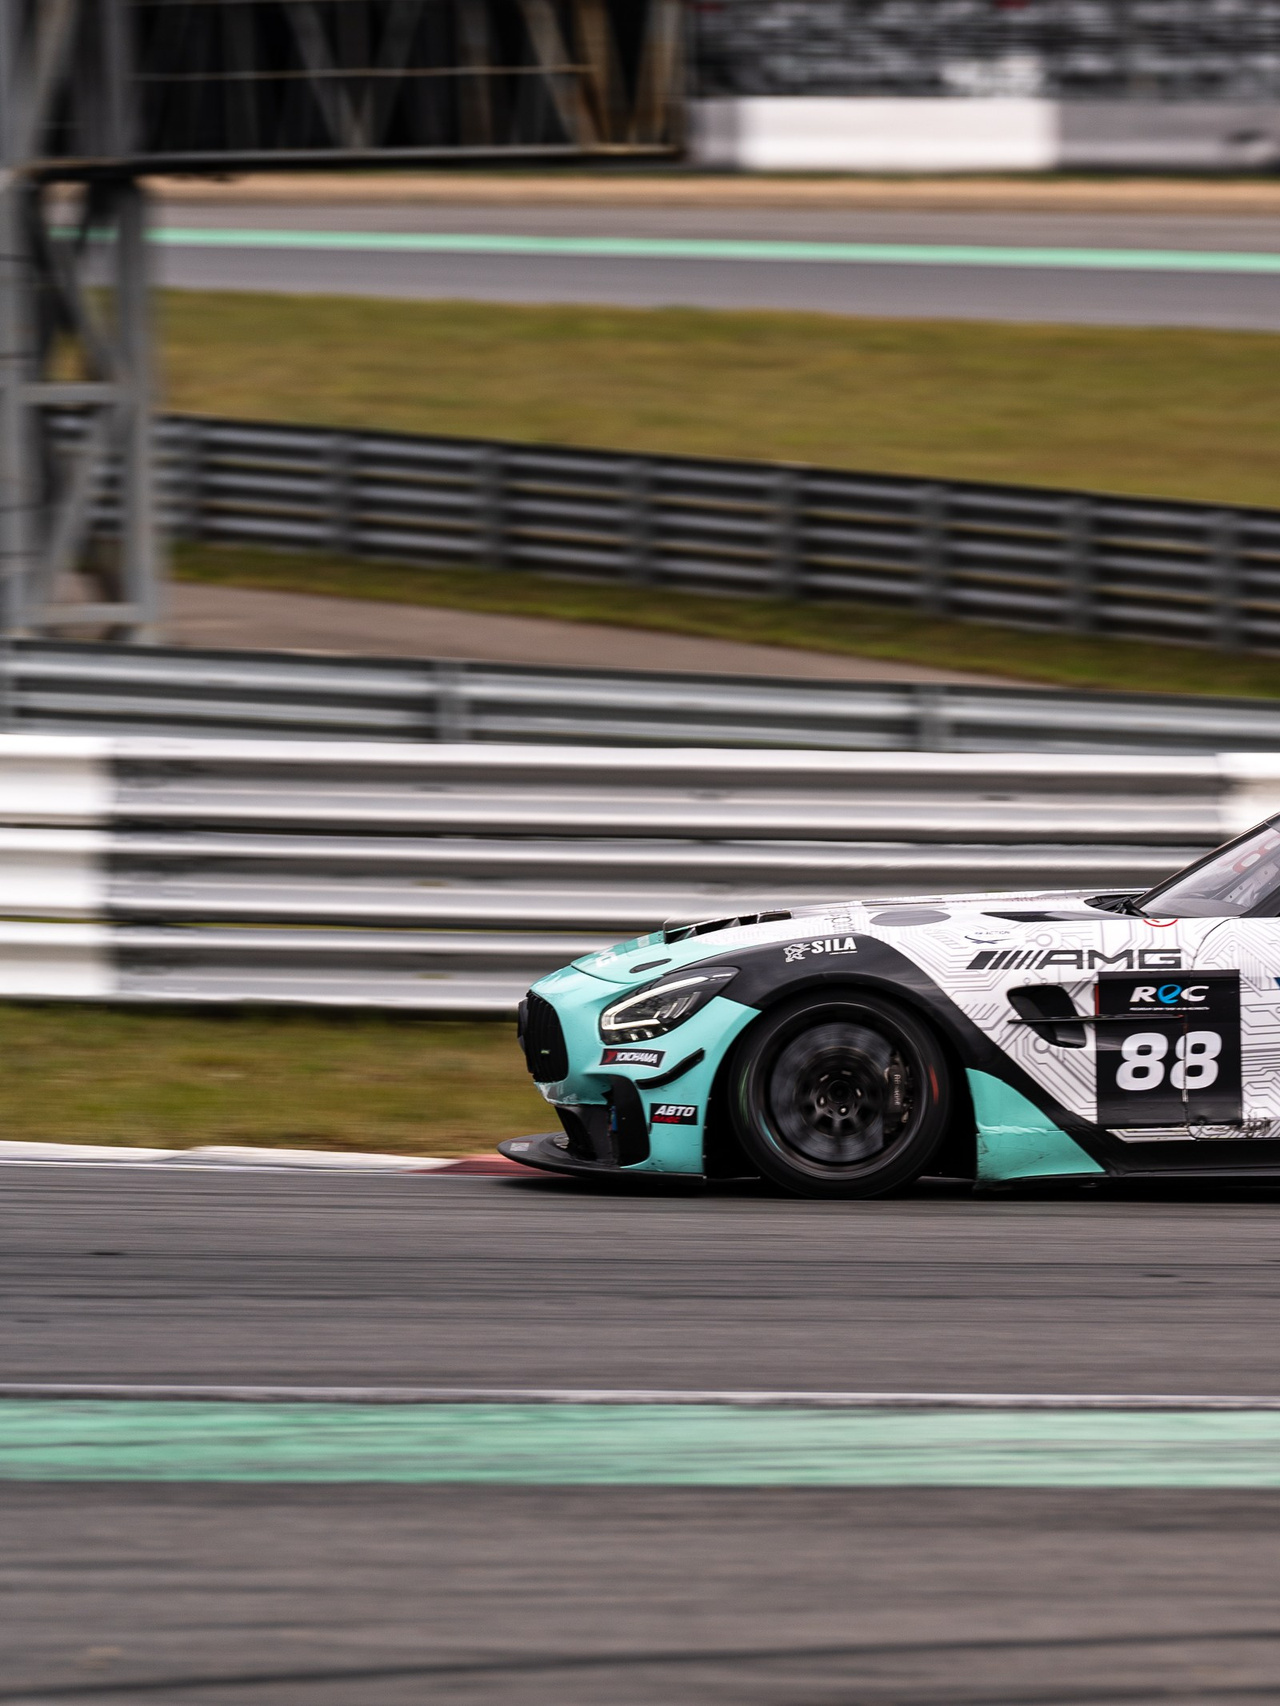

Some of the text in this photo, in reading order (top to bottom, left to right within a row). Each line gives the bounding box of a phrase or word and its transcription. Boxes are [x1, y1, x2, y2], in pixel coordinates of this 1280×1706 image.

[811, 936, 857, 954] SILA
[1035, 949, 1182, 970] AMG
[1115, 1030, 1223, 1091] 88
